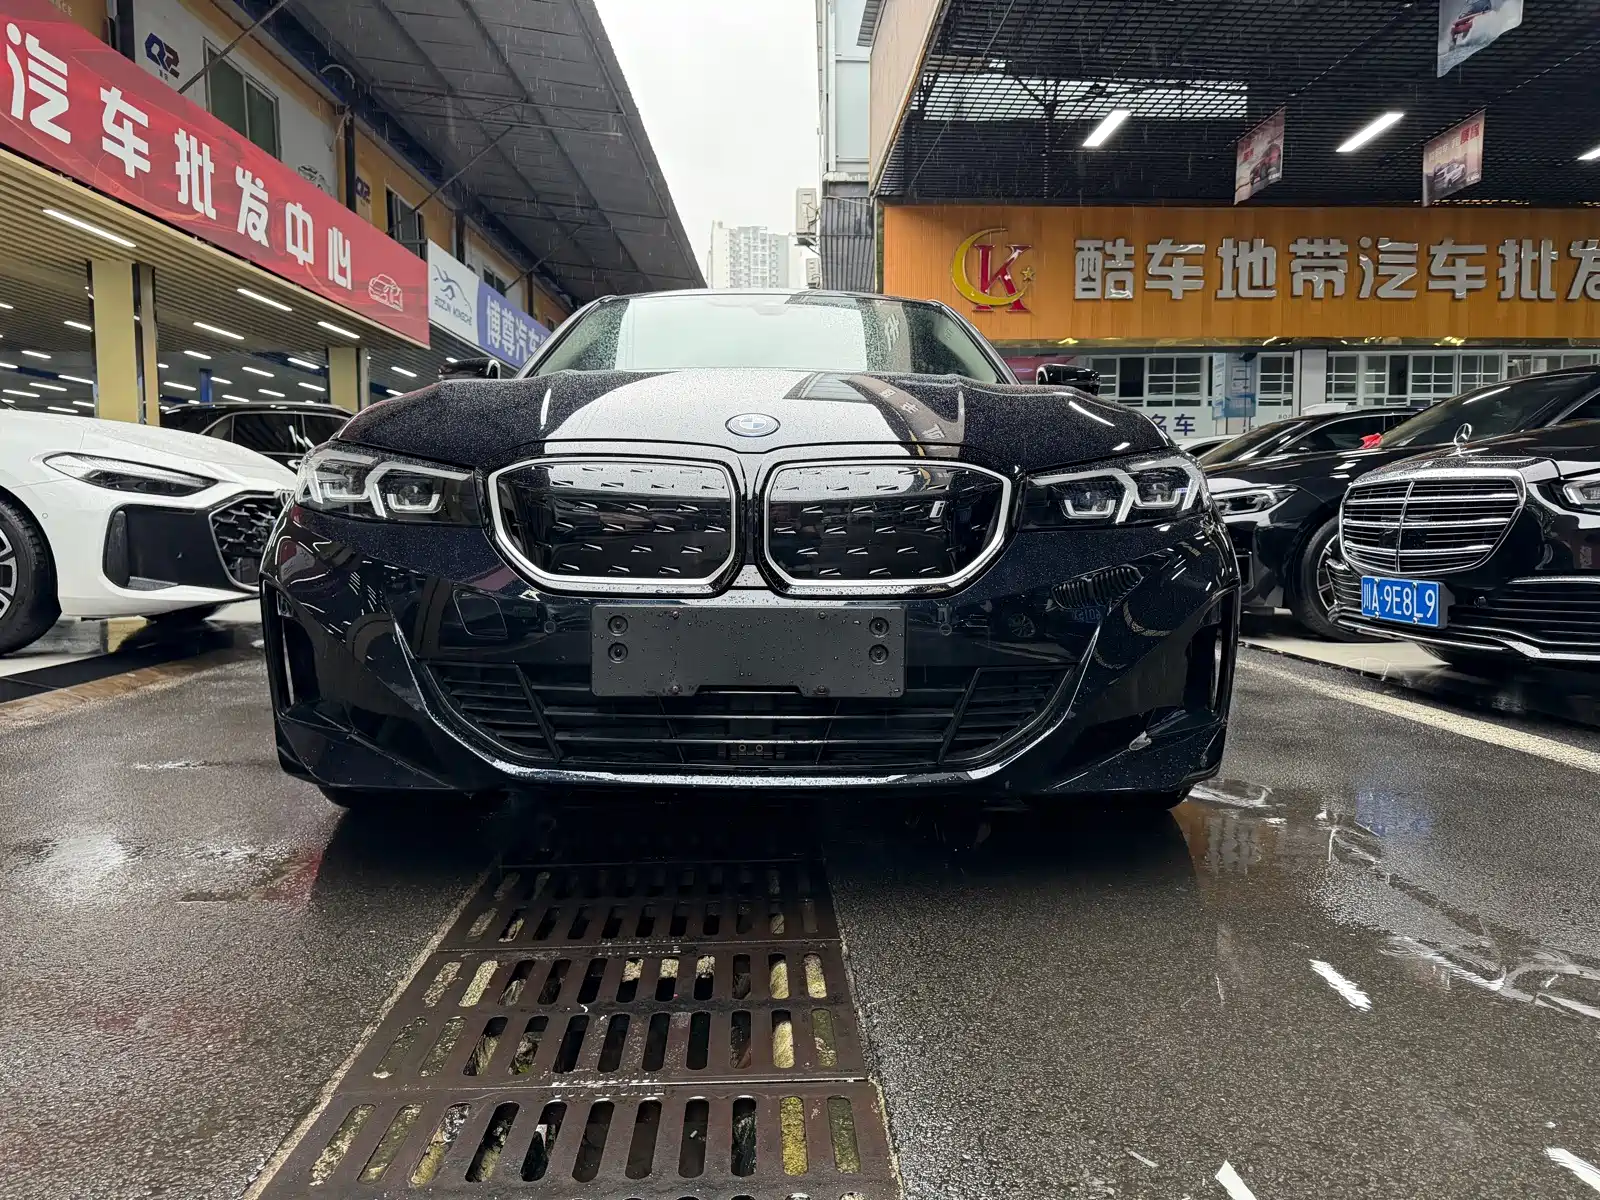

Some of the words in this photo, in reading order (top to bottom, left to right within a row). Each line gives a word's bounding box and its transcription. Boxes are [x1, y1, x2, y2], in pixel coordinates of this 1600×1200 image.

[5, 23, 352, 290] 汽车批发中心
[1074, 237, 1600, 300] 酷车地带汽车批发
